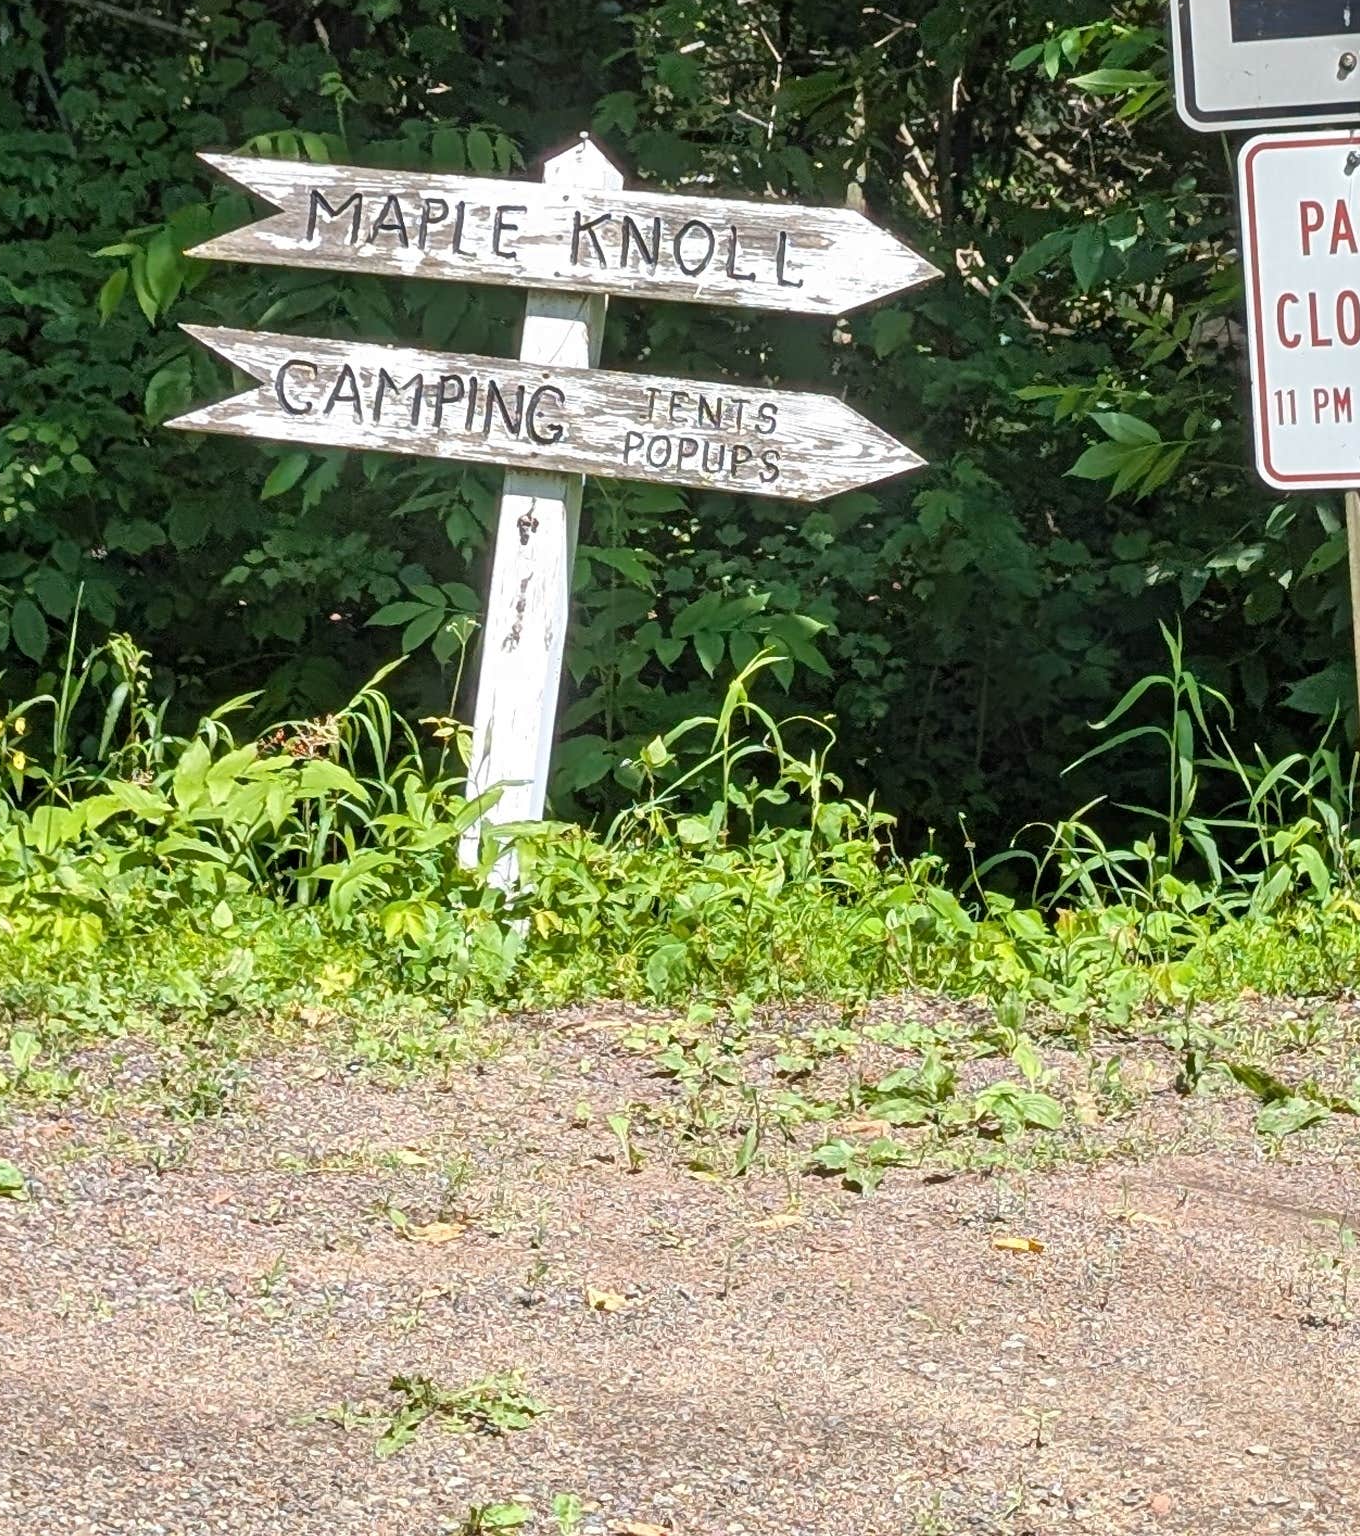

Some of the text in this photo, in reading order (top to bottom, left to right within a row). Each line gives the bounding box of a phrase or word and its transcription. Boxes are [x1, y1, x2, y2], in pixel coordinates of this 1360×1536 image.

[304, 189, 805, 289] MAPLE KNOLL
[275, 358, 568, 445] CAMPING
[640, 385, 780, 436] TENTS
[1273, 388, 1297, 426] 11
[1313, 386, 1353, 425] PM
[622, 429, 782, 484] POPUPS
